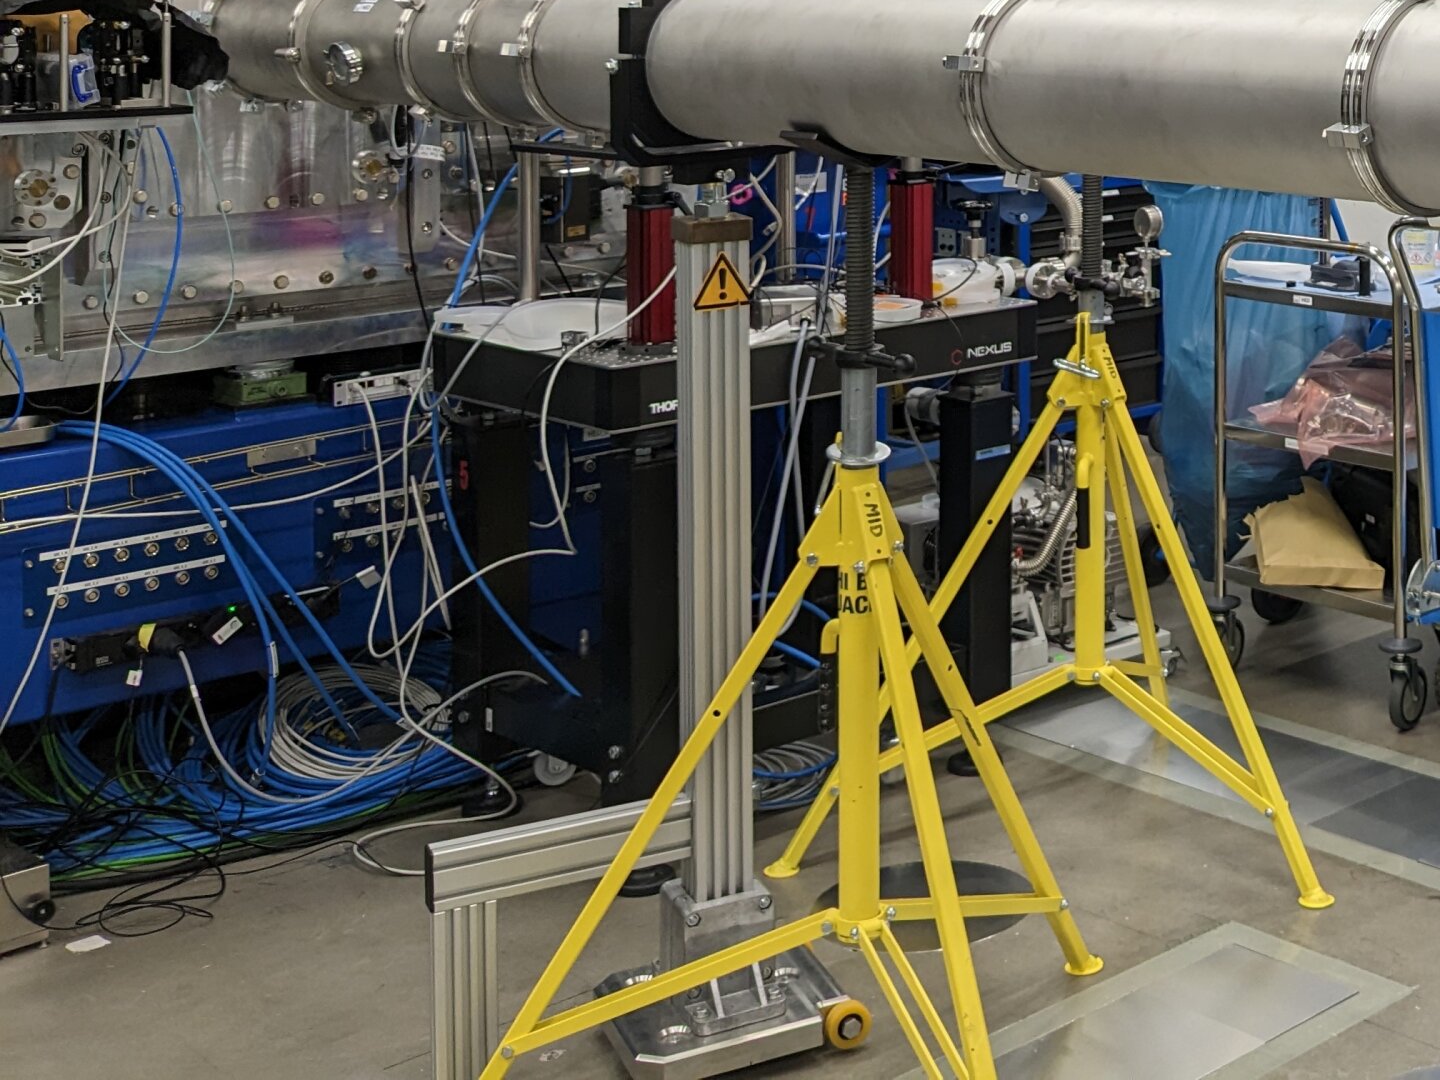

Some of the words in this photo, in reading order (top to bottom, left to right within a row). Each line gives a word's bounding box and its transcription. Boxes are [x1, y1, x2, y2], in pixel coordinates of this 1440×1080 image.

[966, 341, 1013, 359] NEXUS
[1102, 356, 1117, 380] MID
[863, 503, 883, 538] MID
